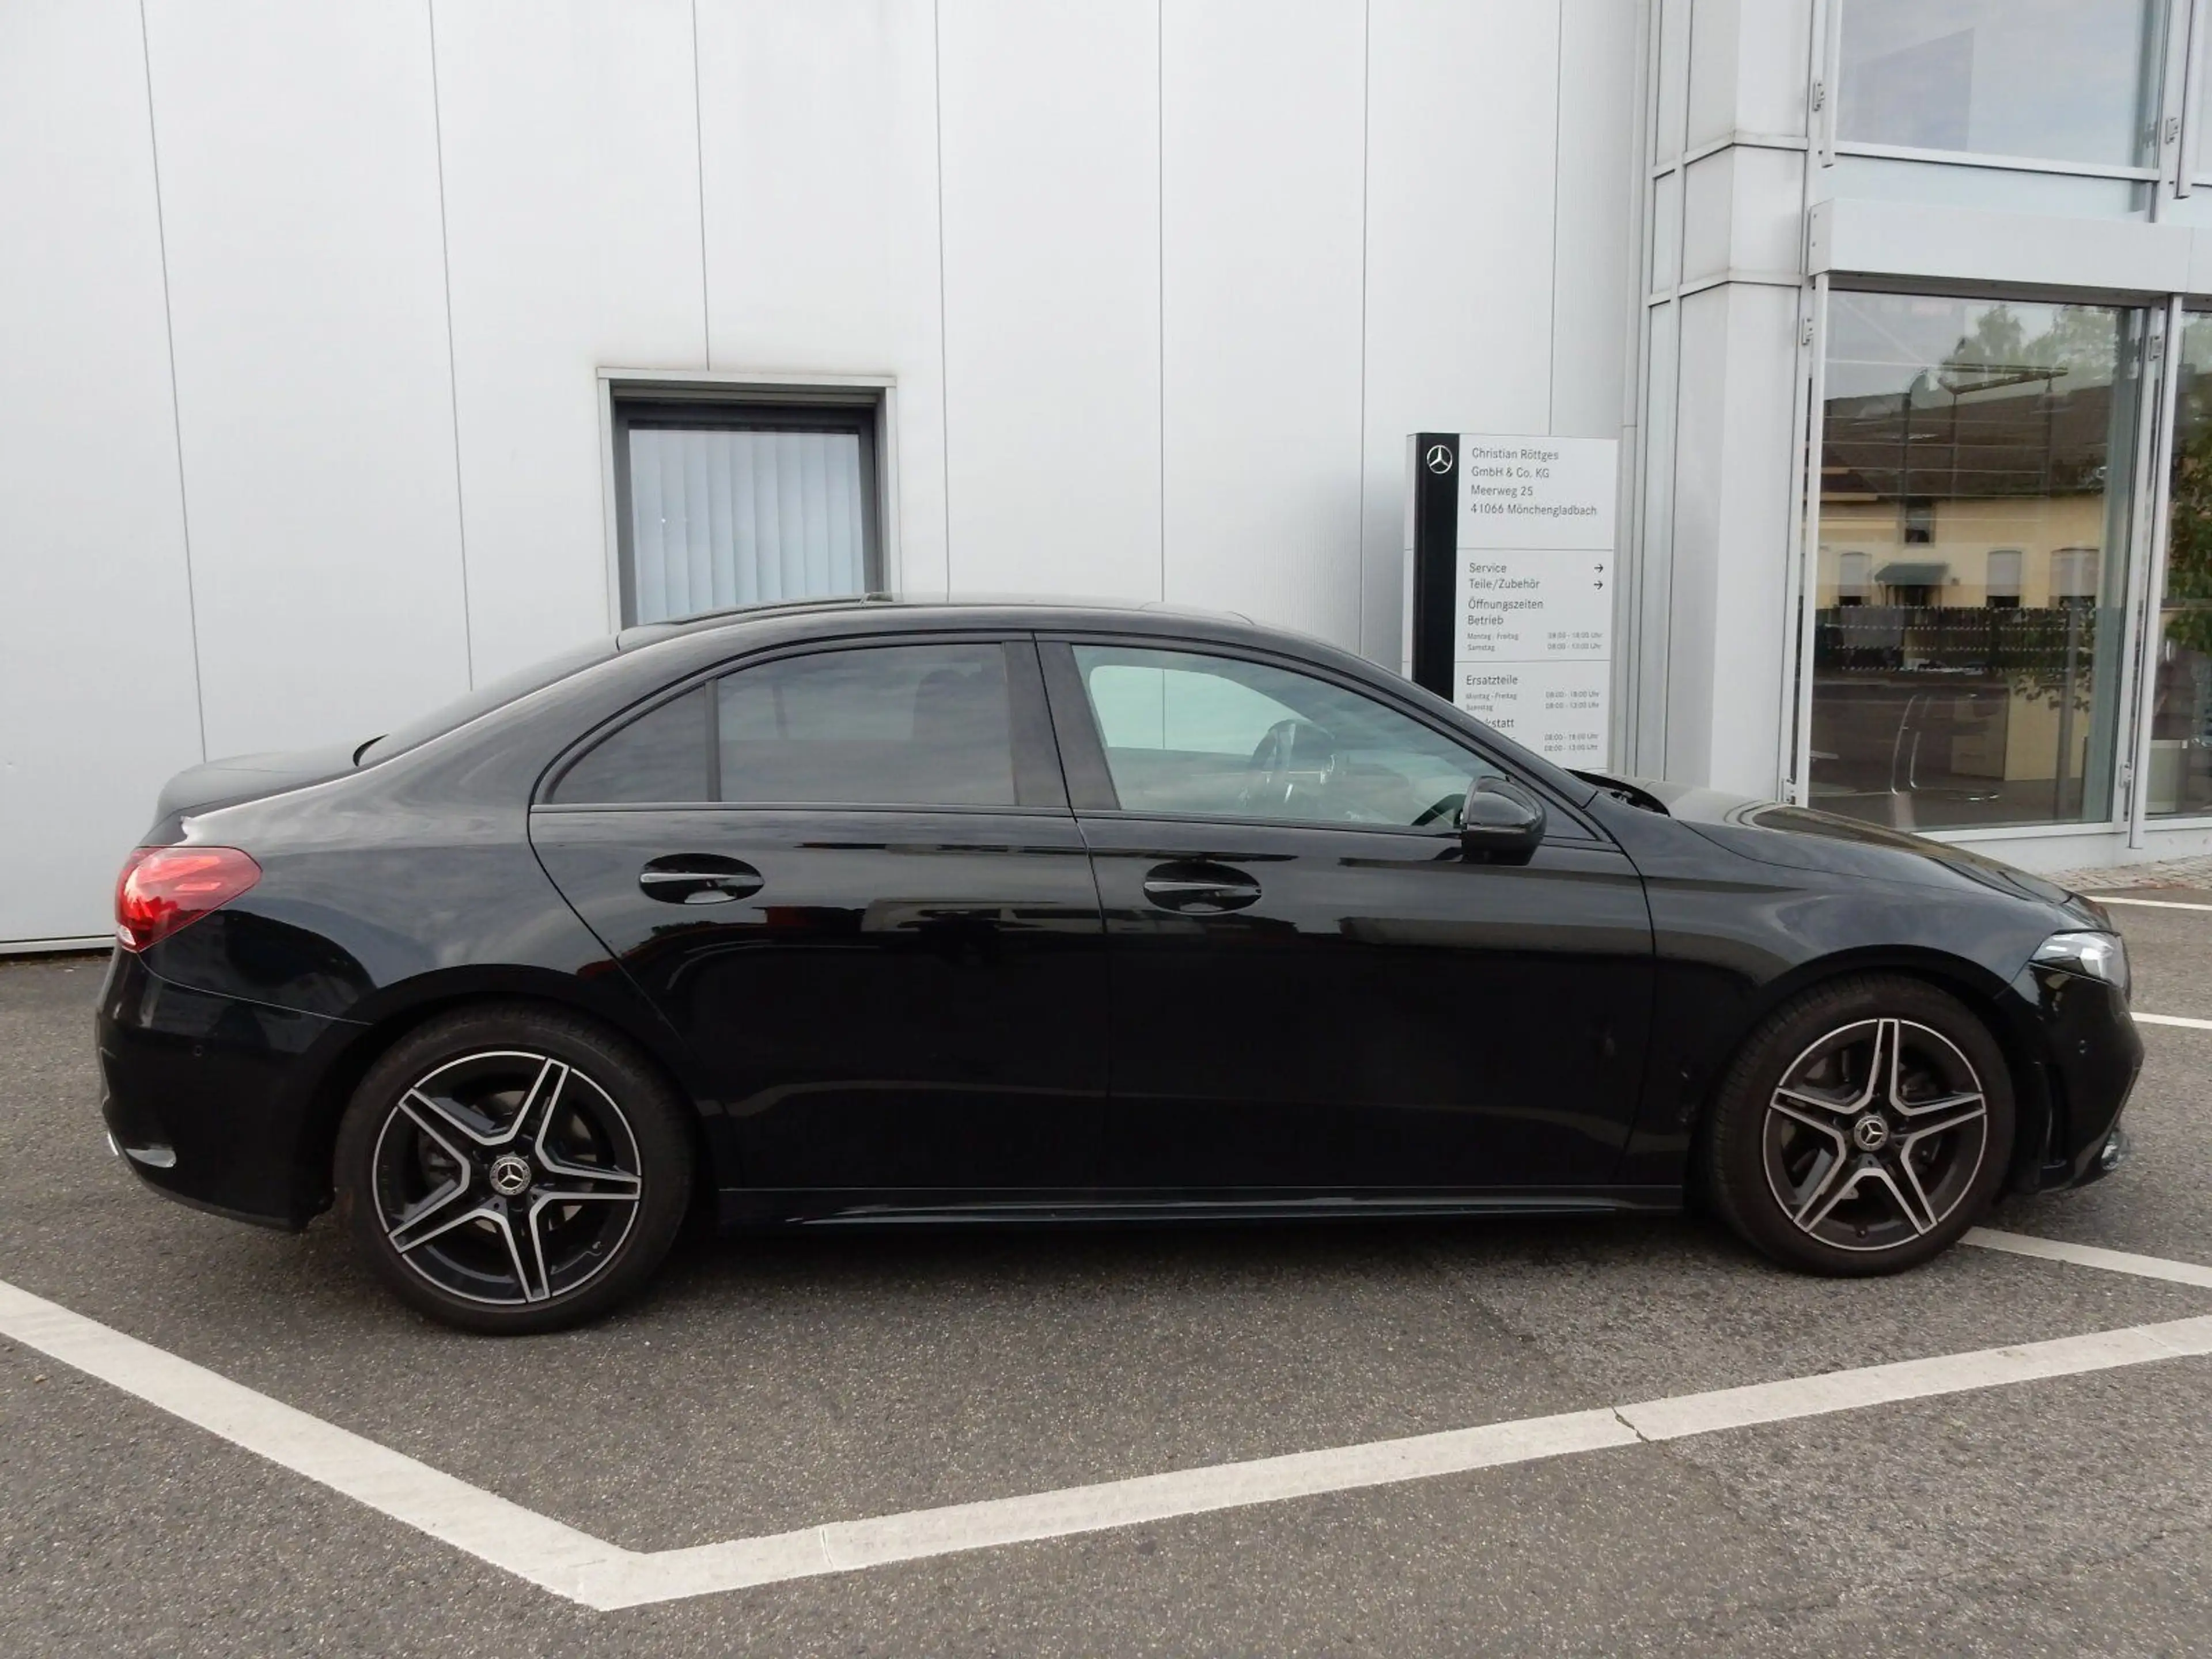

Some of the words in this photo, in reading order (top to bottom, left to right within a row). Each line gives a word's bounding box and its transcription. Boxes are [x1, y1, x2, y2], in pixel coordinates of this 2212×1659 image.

[1472, 448, 1517, 459] Christian
[1520, 449, 1559, 463] Röttges
[1471, 467, 1504, 477] GmbH
[1506, 468, 1513, 478] &
[1516, 468, 1531, 479] Co.
[1536, 468, 1550, 478] KG
[1471, 485, 1518, 498] Meerweg
[1520, 486, 1533, 496] 25
[1470, 503, 1504, 514] 41066
[1507, 504, 1597, 517] Mönchengladbach
[1469, 562, 1507, 573] Service
[1469, 578, 1540, 589] Teile/Zubehör
[1468, 599, 1544, 612] Öffnungszeiten
[1467, 615, 1504, 626] Betrieb
[1466, 675, 1518, 686] Ersatzteile
